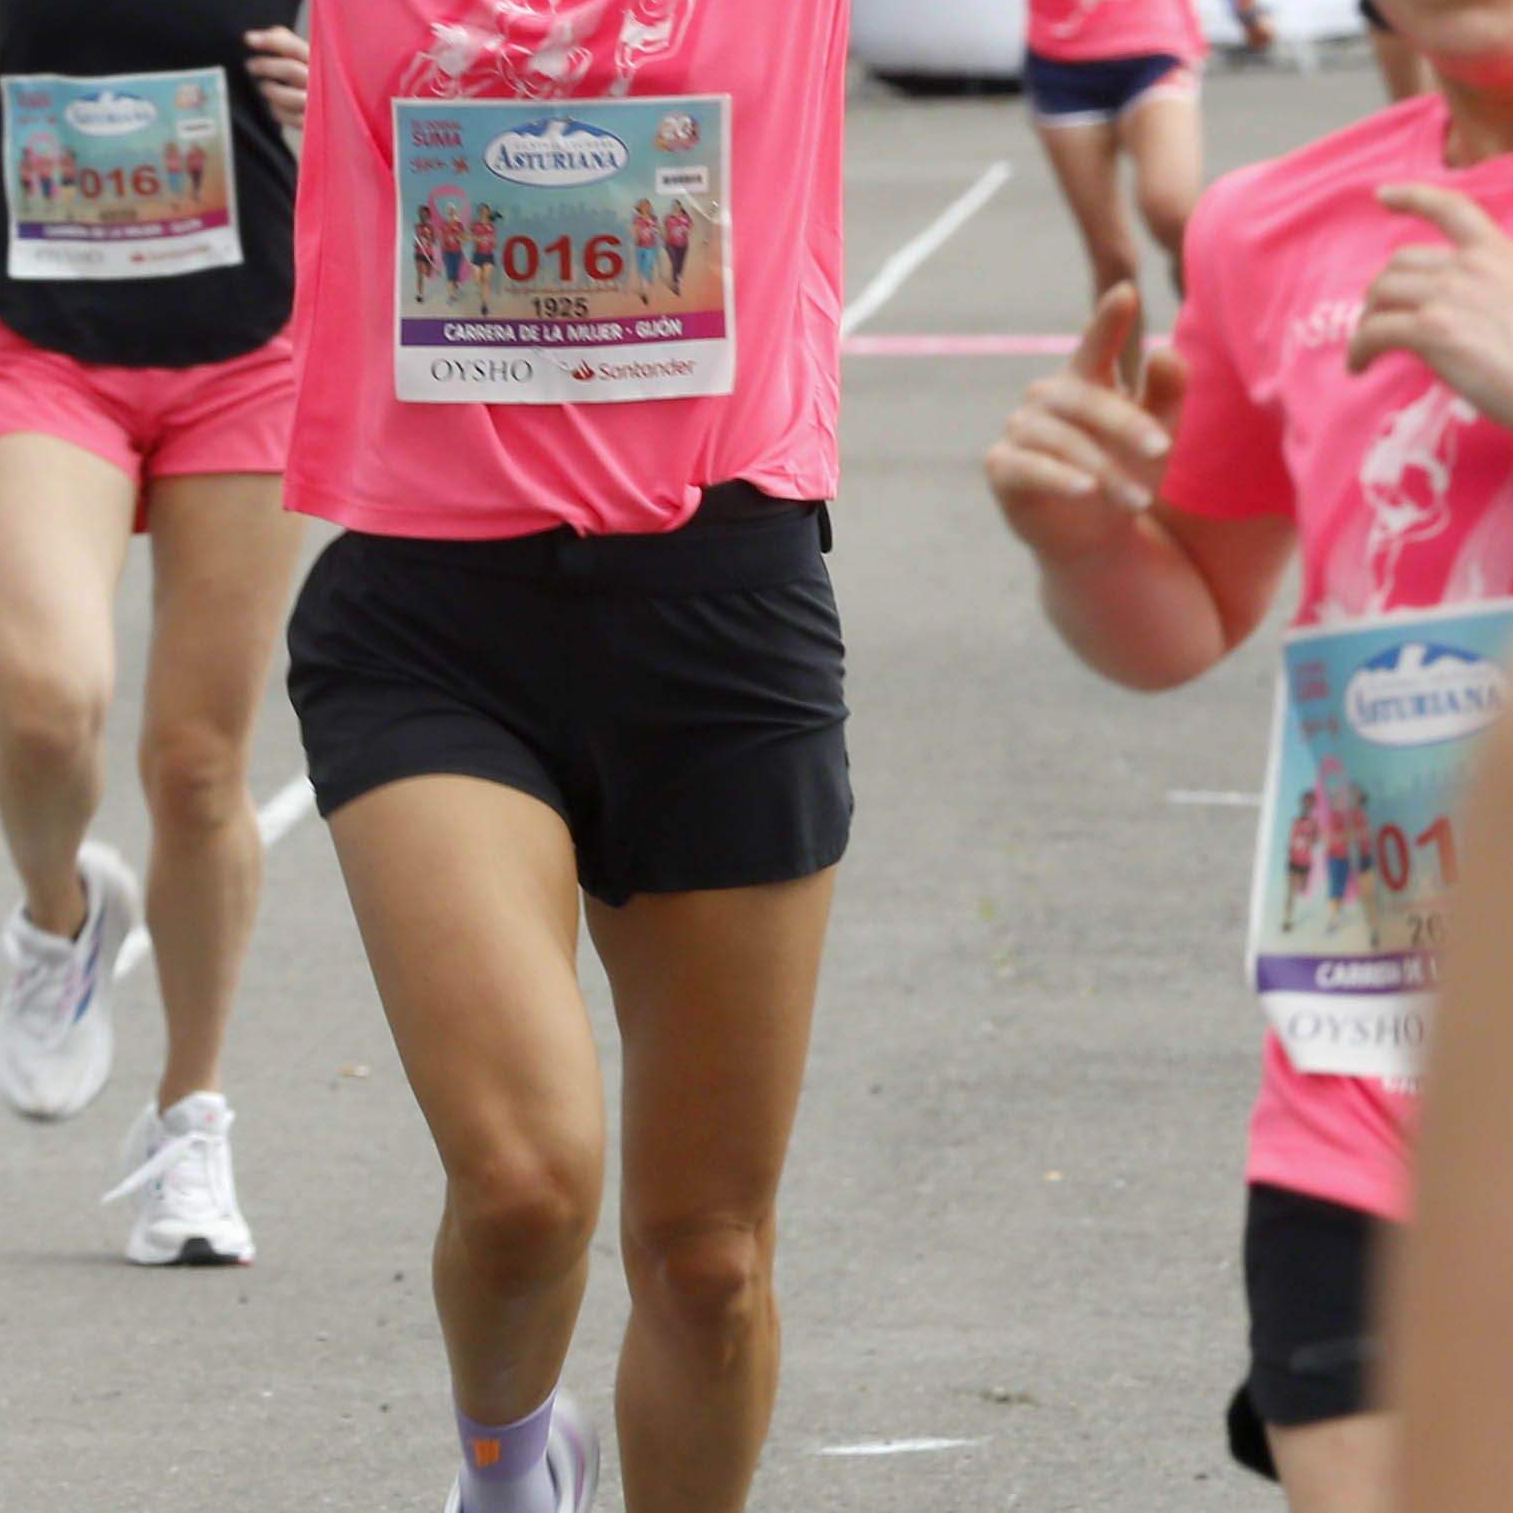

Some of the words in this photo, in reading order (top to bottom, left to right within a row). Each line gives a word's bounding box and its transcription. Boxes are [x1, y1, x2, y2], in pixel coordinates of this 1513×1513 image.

[493, 143, 621, 171] ASTURIANA
[80, 165, 161, 200] 016
[502, 234, 624, 283] 016
[533, 296, 589, 319] 1925
[443, 322, 516, 342] CARRERA
[518, 324, 541, 342] DE
[543, 324, 565, 342] LA
[431, 358, 534, 383] OYSHO
[597, 357, 698, 383] Santander
[1377, 814, 1462, 892] 01
[1288, 1010, 1424, 1048] OYSHO
